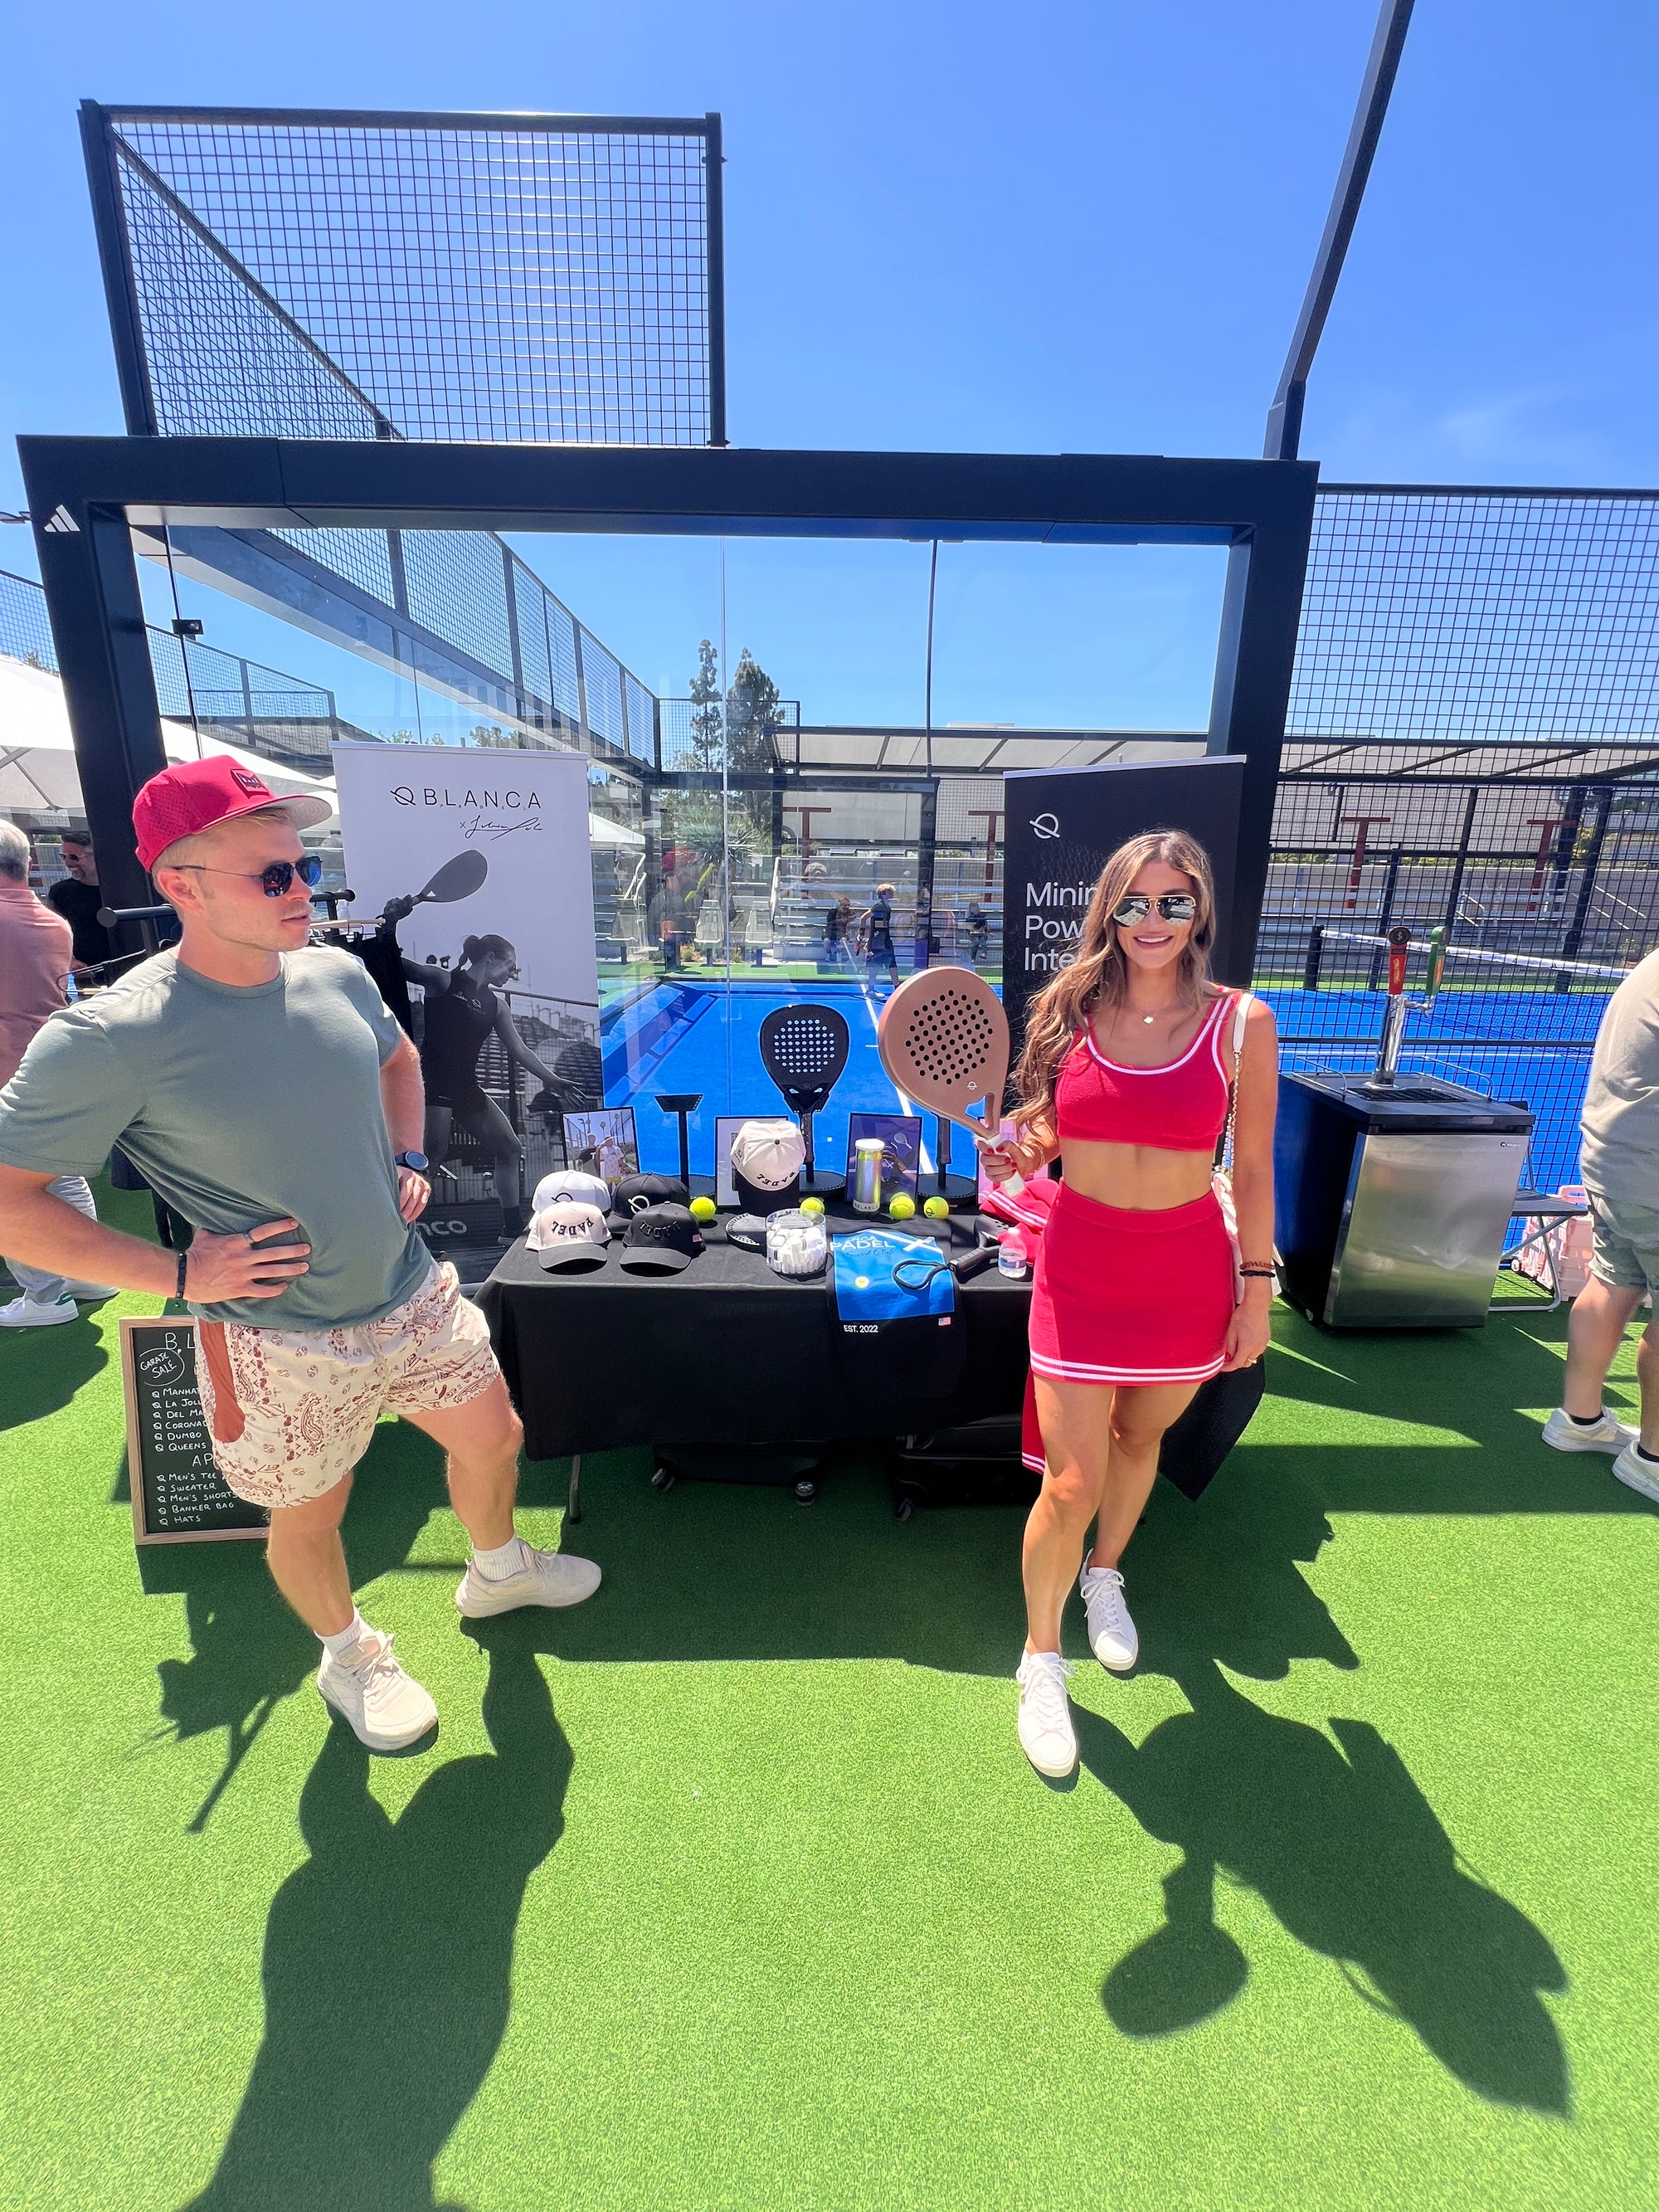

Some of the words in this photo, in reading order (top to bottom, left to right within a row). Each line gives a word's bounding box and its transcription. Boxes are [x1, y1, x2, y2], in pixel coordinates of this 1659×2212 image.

[423, 788, 542, 809] BLANCA
[551, 1216, 595, 1235] PADEL
[830, 1240, 896, 1251] PADEL
[844, 1324, 859, 1333] EST.
[859, 1324, 878, 1333] 2022
[152, 1360, 178, 1378] SALE
[165, 1400, 178, 1408] LA
[167, 1411, 184, 1419] DEL
[167, 1431, 202, 1440] DUMBO
[168, 1442, 207, 1451] QUEENS
[170, 1483, 216, 1492] SWEATER
[172, 1503, 211, 1513] BANKER
[173, 1515, 201, 1523] HATS
